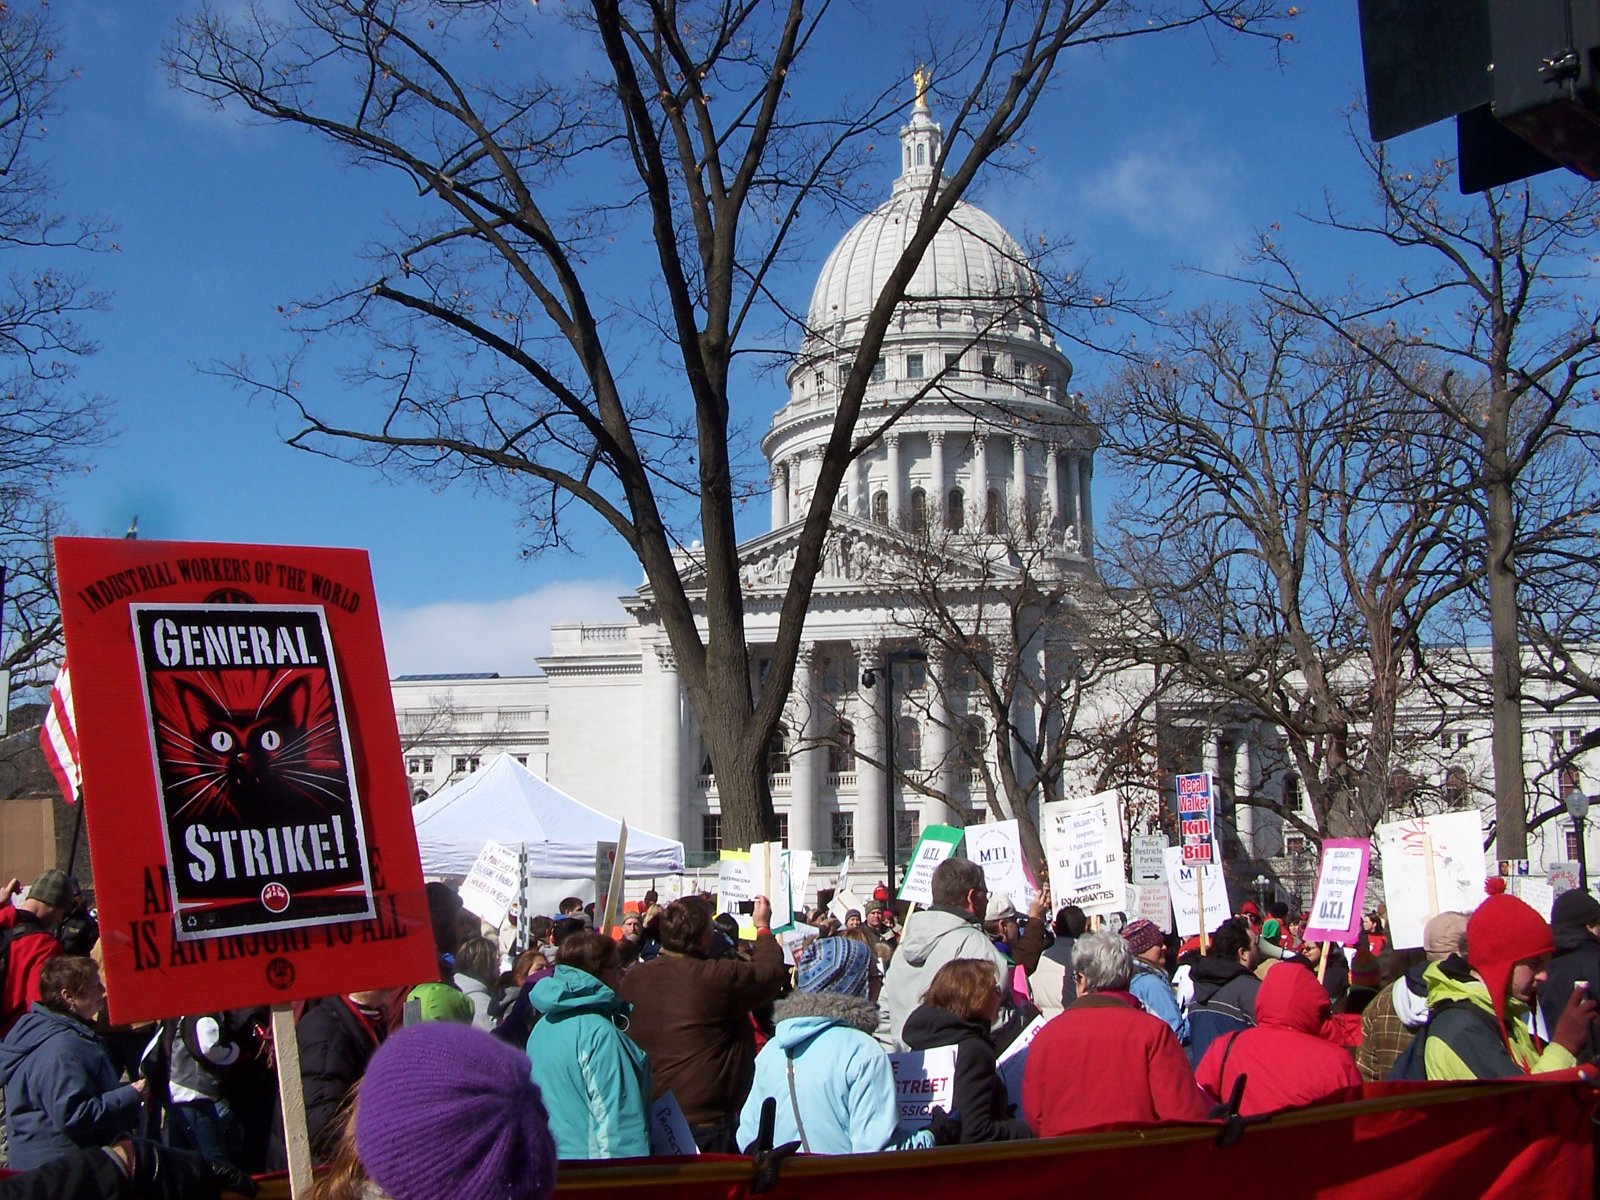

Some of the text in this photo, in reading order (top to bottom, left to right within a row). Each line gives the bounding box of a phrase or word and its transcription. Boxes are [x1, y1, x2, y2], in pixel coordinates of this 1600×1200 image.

[77, 562, 177, 614] INDUSTRIAL
[177, 557, 250, 584] WORKERS
[254, 560, 273, 586] OF
[276, 564, 306, 593] THE
[311, 572, 360, 614] WORLD
[153, 618, 318, 667] GENERAL
[1180, 776, 1207, 793] Recall
[1179, 795, 1210, 812] Walker
[1182, 820, 1209, 835] Kill
[184, 814, 349, 882] STRIKE!
[1141, 838, 1159, 847] Police
[1184, 843, 1211, 859] Bill
[980, 846, 1008, 862] MTI
[1140, 855, 1162, 864] Parking
[1074, 860, 1102, 880] U.T.I.
[1180, 865, 1208, 880] MI
[1182, 904, 1220, 916] Solidrity!
[1319, 901, 1345, 919] U.T.I.
[129, 919, 161, 971] IS
